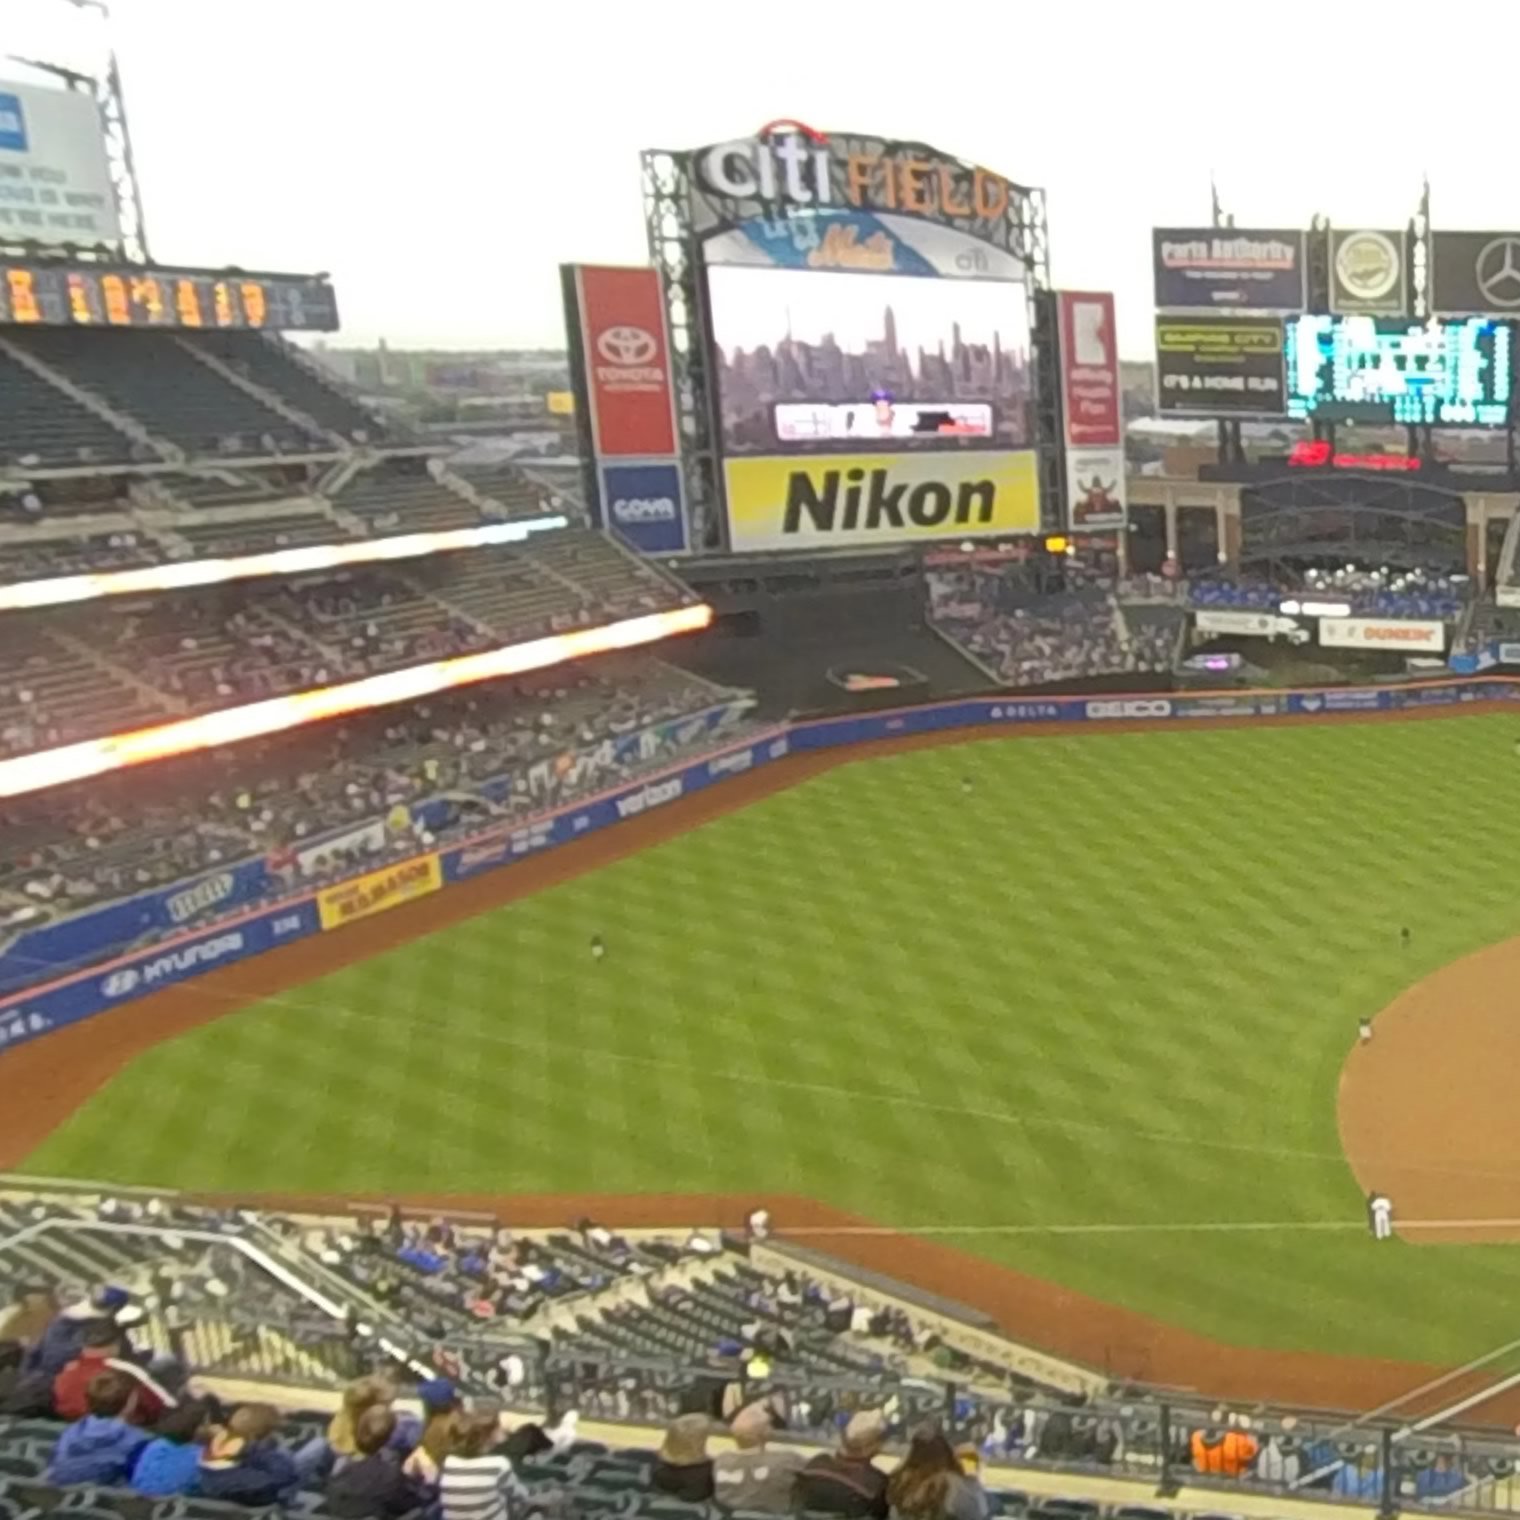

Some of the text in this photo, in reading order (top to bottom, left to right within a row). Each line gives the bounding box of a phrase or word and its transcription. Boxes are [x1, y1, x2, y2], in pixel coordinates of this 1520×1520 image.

[707, 134, 1010, 218] citi FIELD
[596, 366, 664, 382] TOYOTA
[782, 468, 996, 533] Nikon
[1085, 701, 1171, 719] GEICO
[616, 778, 683, 817] verizon
[143, 932, 244, 982] HYUNDAI
